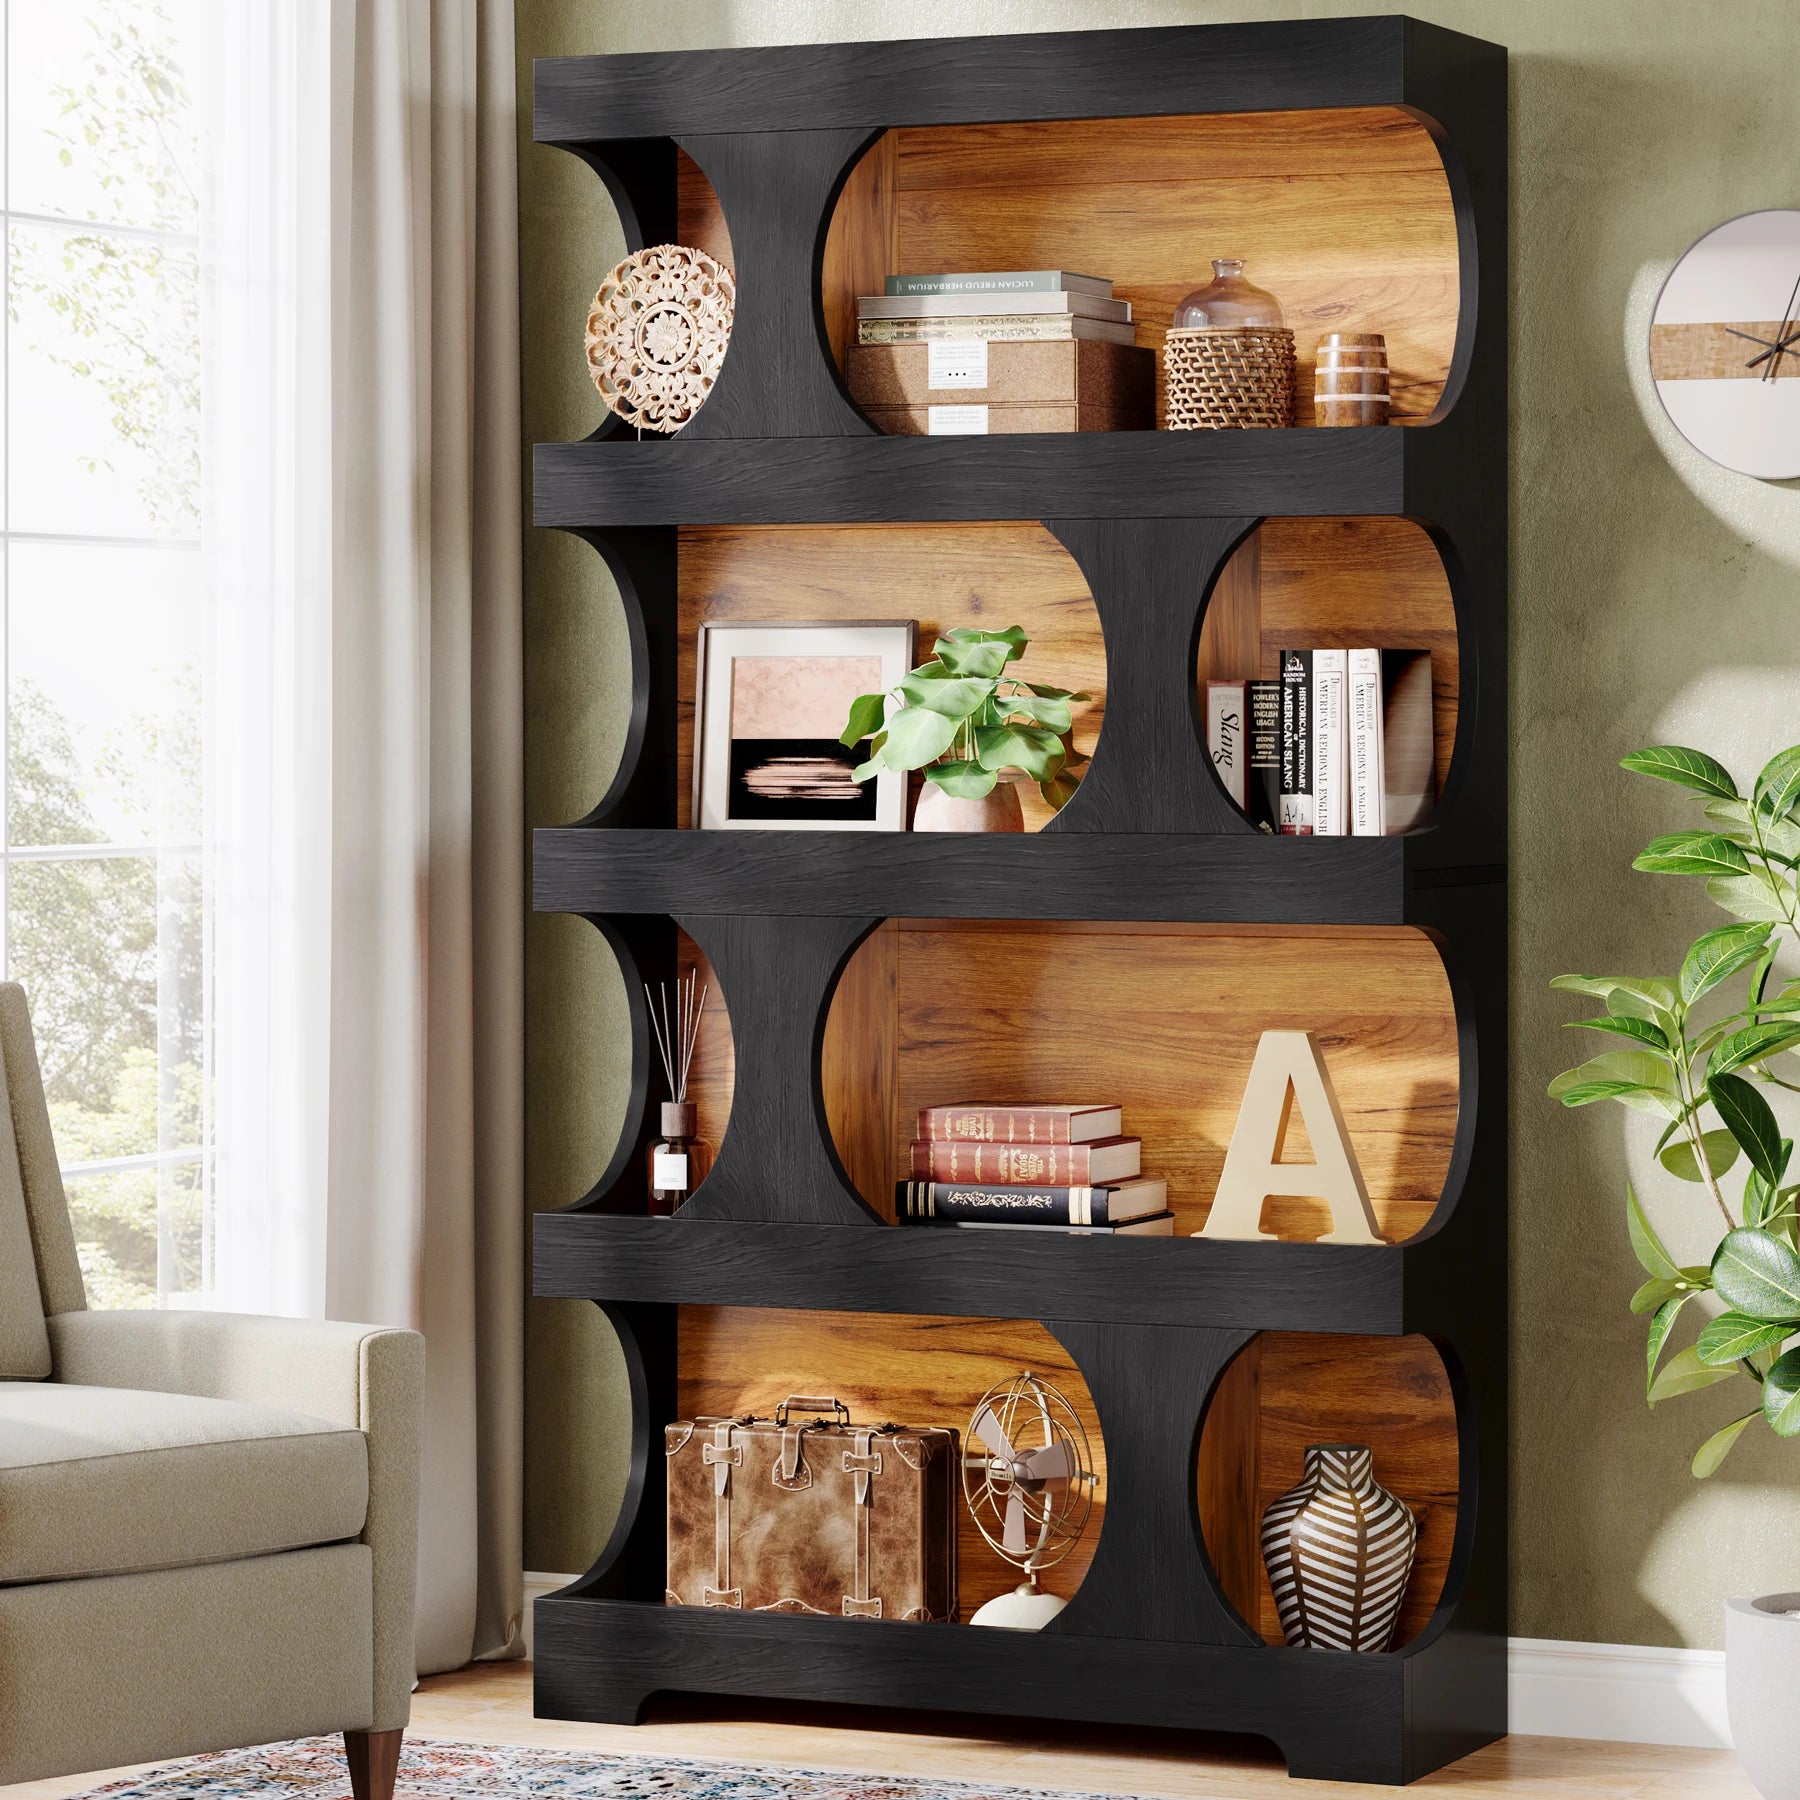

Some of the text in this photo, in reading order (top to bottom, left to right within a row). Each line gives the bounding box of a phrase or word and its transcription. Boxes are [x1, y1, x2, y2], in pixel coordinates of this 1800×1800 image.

[908, 282, 963, 291] HERBARIUM
[965, 281, 995, 290] FREUD
[998, 280, 1034, 288] LUCIAN
[1253, 693, 1280, 702] FOWLER'S
[1253, 702, 1279, 710] MODERN
[1330, 677, 1340, 720] DICTIONARY
[1366, 682, 1375, 721] DICTIONARY
[1213, 708, 1240, 768] Slang
[1256, 719, 1275, 727] USAGE
[1283, 687, 1293, 789] AMERICAN SLANG
[1298, 686, 1307, 789] HISTORICAL DICTIONARY
[1318, 679, 1328, 833] AMERICAN REGIONAL ENGLISH
[1355, 684, 1366, 827] AMERICAN REGIONAL ENGLISH
[1190, 1030, 1392, 1244] A
